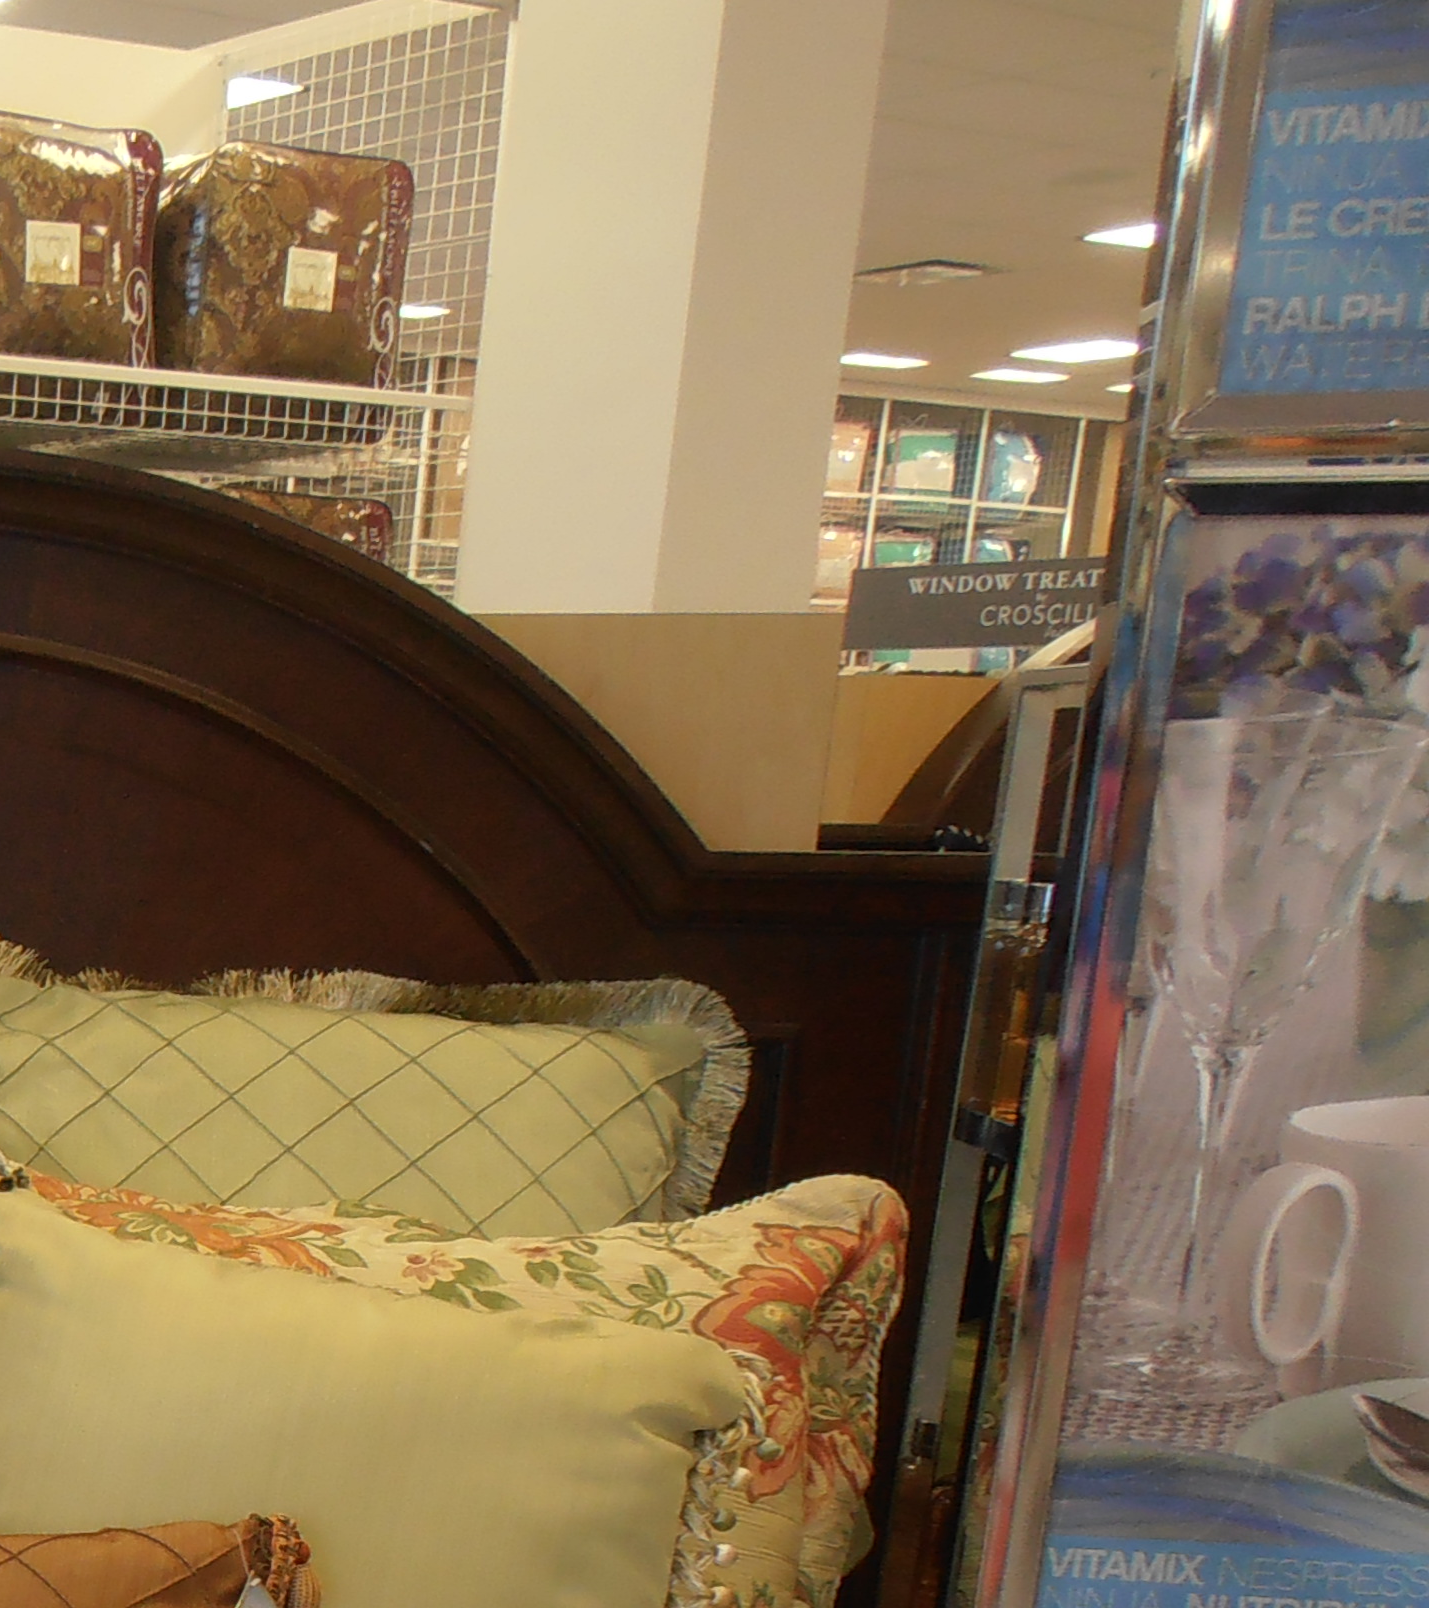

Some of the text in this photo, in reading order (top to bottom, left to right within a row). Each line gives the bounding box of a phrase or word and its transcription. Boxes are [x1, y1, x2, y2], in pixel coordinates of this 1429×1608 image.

[1259, 202, 1322, 242] LE
[1242, 292, 1409, 335] RALPH
[908, 572, 1019, 595] WINDOW
[1046, 1547, 1208, 1585] VITAMIX
